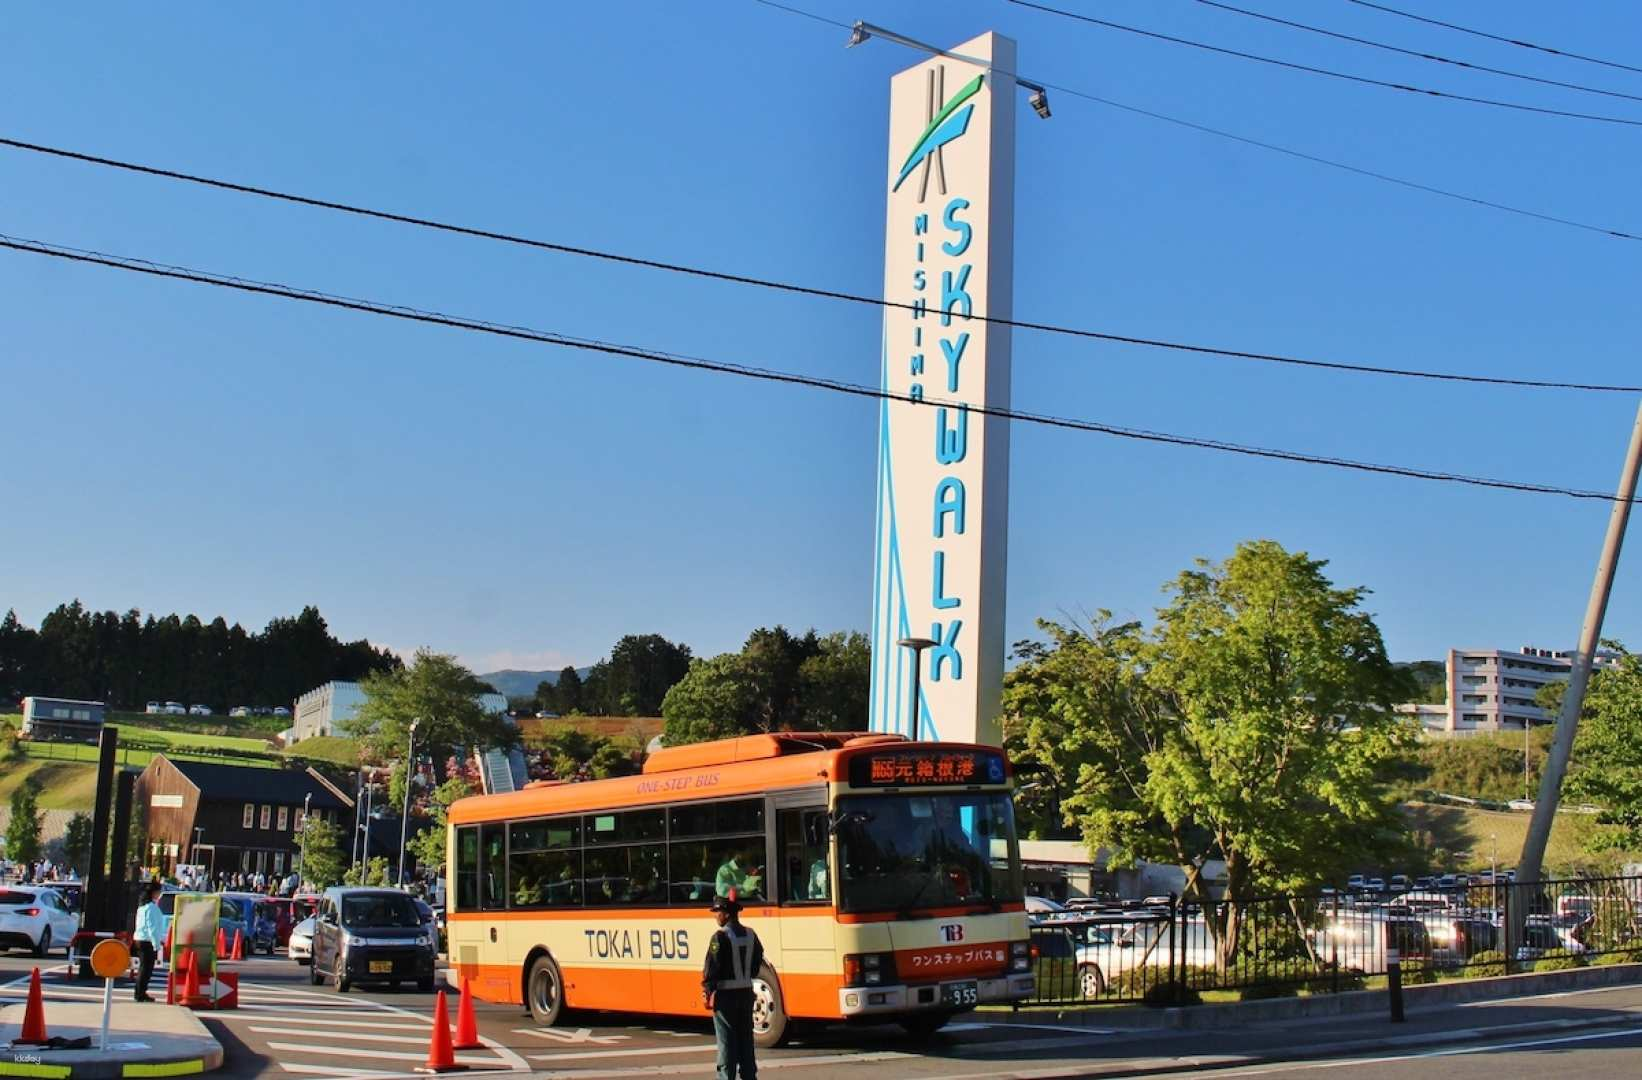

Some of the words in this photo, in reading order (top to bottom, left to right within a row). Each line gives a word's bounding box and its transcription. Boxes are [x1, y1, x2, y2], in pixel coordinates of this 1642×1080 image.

[910, 213, 928, 405] MISHIMA
[930, 198, 973, 682] SKYWALK
[895, 757, 974, 777] 元箱根港
[636, 777, 692, 794] ONE-STEP
[695, 773, 720, 787] BUS
[584, 929, 642, 959] TOKAI
[650, 929, 689, 959] BUS
[912, 950, 993, 967] ワンステップバス
